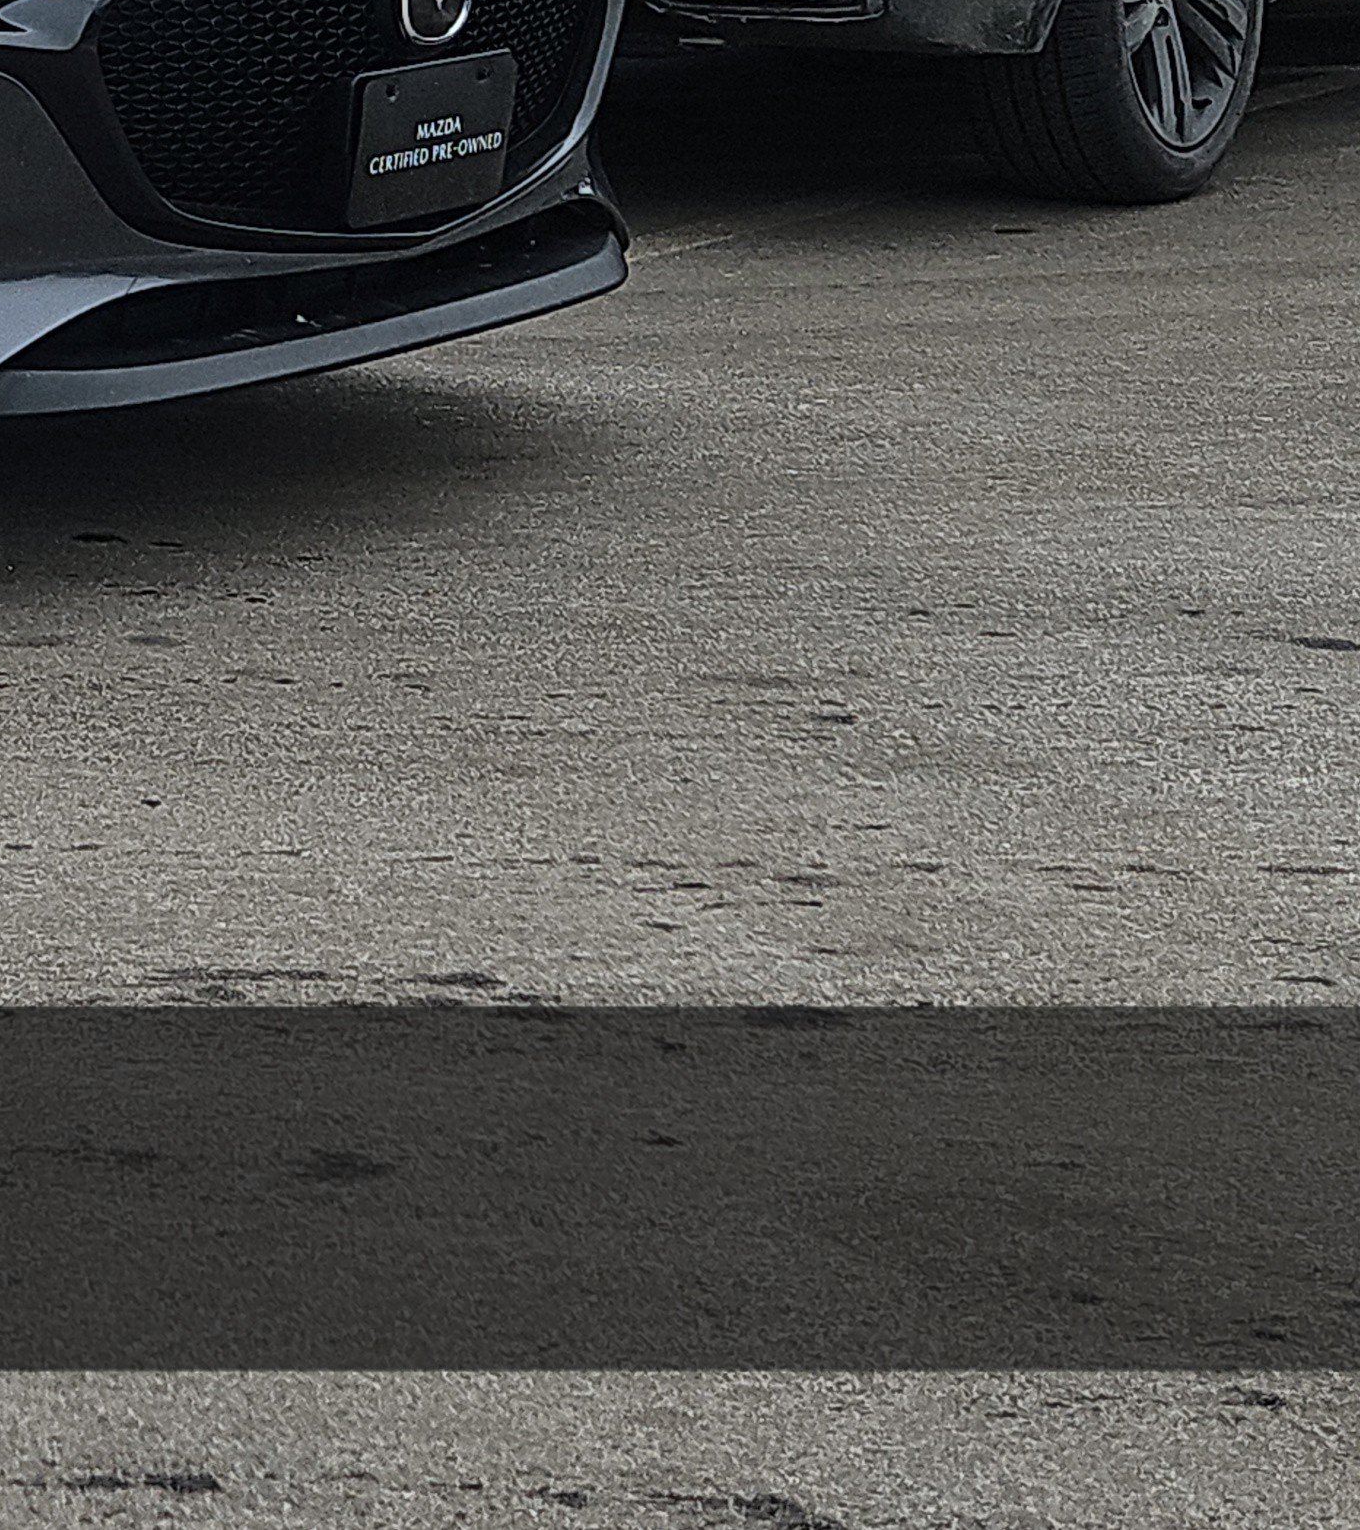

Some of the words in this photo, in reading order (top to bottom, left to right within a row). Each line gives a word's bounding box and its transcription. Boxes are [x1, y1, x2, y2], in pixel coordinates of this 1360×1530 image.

[416, 116, 461, 140] MAZDA
[369, 147, 429, 175] CERTIFIED
[432, 132, 503, 163] PRE-OWNED
